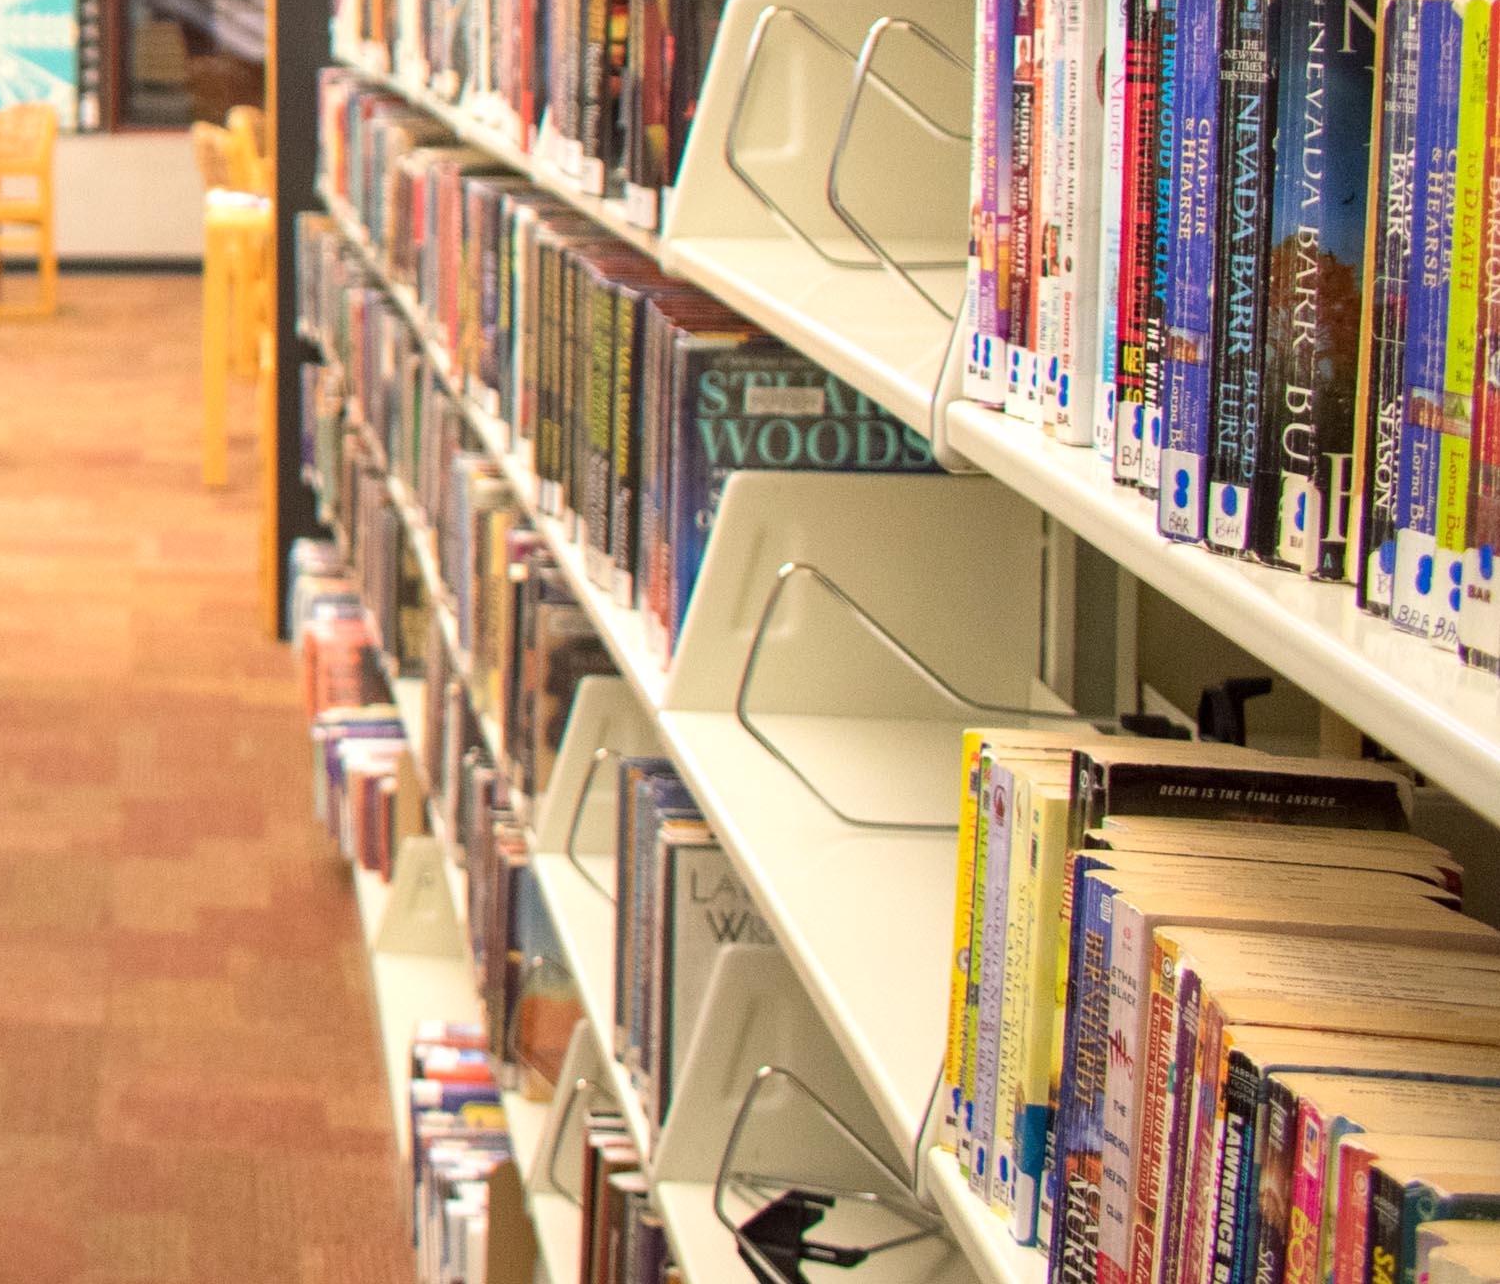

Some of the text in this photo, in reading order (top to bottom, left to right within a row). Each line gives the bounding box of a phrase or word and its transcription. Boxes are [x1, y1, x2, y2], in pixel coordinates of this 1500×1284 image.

[1110, 74, 1126, 172] Murder
[1300, 19, 1327, 211] NEVADA
[1154, 32, 1177, 303] LINWOOD BARCLAY
[1178, 138, 1199, 241] HEARSE
[1194, 117, 1211, 235] CHAPTER
[1385, 152, 1408, 240] BARR
[1015, 176, 1029, 279] SHE WROTE
[1227, 93, 1262, 357] NEVADA BARR
[1459, 185, 1480, 293] DEATH
[1147, 317, 1161, 354] THE
[1292, 222, 1322, 352] BARR
[698, 418, 936, 469] WOODS
[1217, 381, 1239, 460] LURE
[1242, 368, 1260, 480] BLOOD
[1374, 402, 1398, 512] SEASON
[1159, 783, 1281, 804] DEATH IS THE FINAL
[1073, 926, 1105, 1106] BERNHARDT
[1110, 965, 1138, 991] ETHAN
[1110, 984, 1137, 1008] BLACK
[1112, 1098, 1128, 1117] THE
[1216, 1111, 1244, 1258] LAWRENCE
